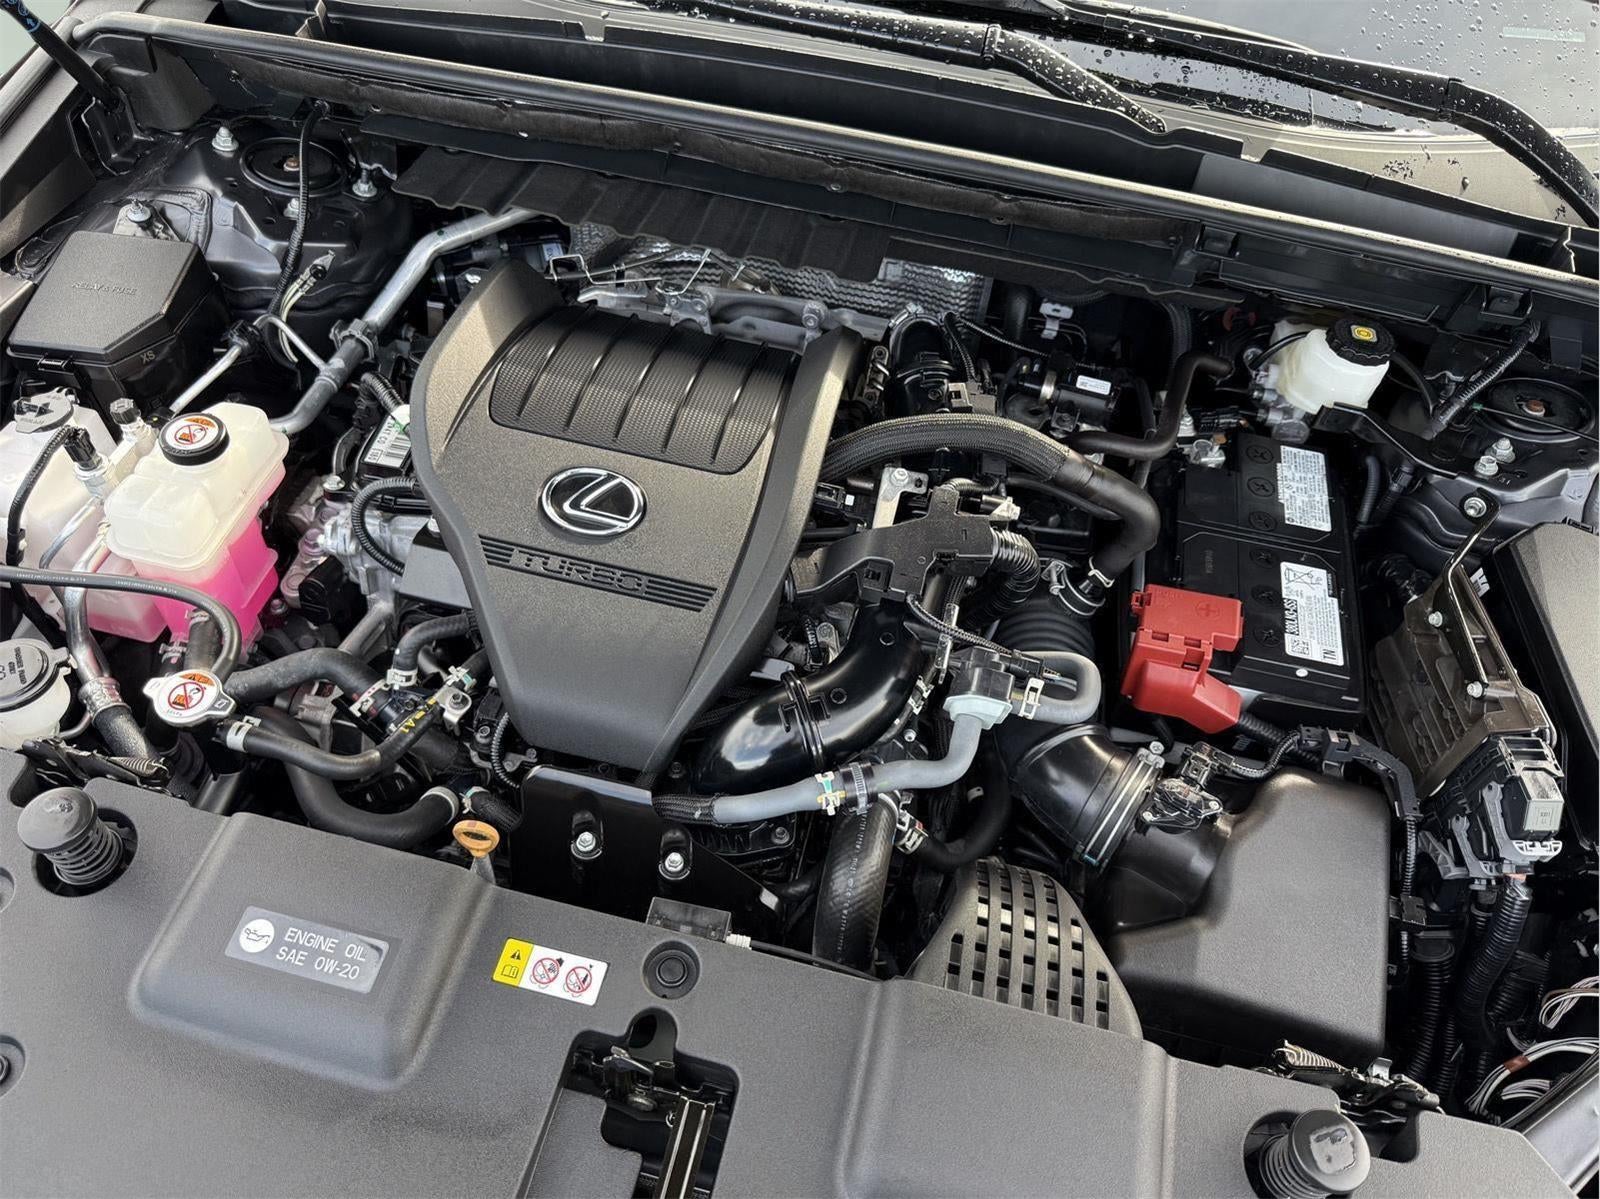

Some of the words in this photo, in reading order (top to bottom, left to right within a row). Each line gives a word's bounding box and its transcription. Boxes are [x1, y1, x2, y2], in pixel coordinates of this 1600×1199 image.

[140, 350, 156, 365] XS
[516, 549, 644, 592] TURBO
[1323, 648, 1337, 660] TN
[284, 927, 339, 953] ENGINE
[344, 943, 367, 961] OIL
[276, 946, 308, 966] SAE
[314, 956, 360, 980] 0W-20
